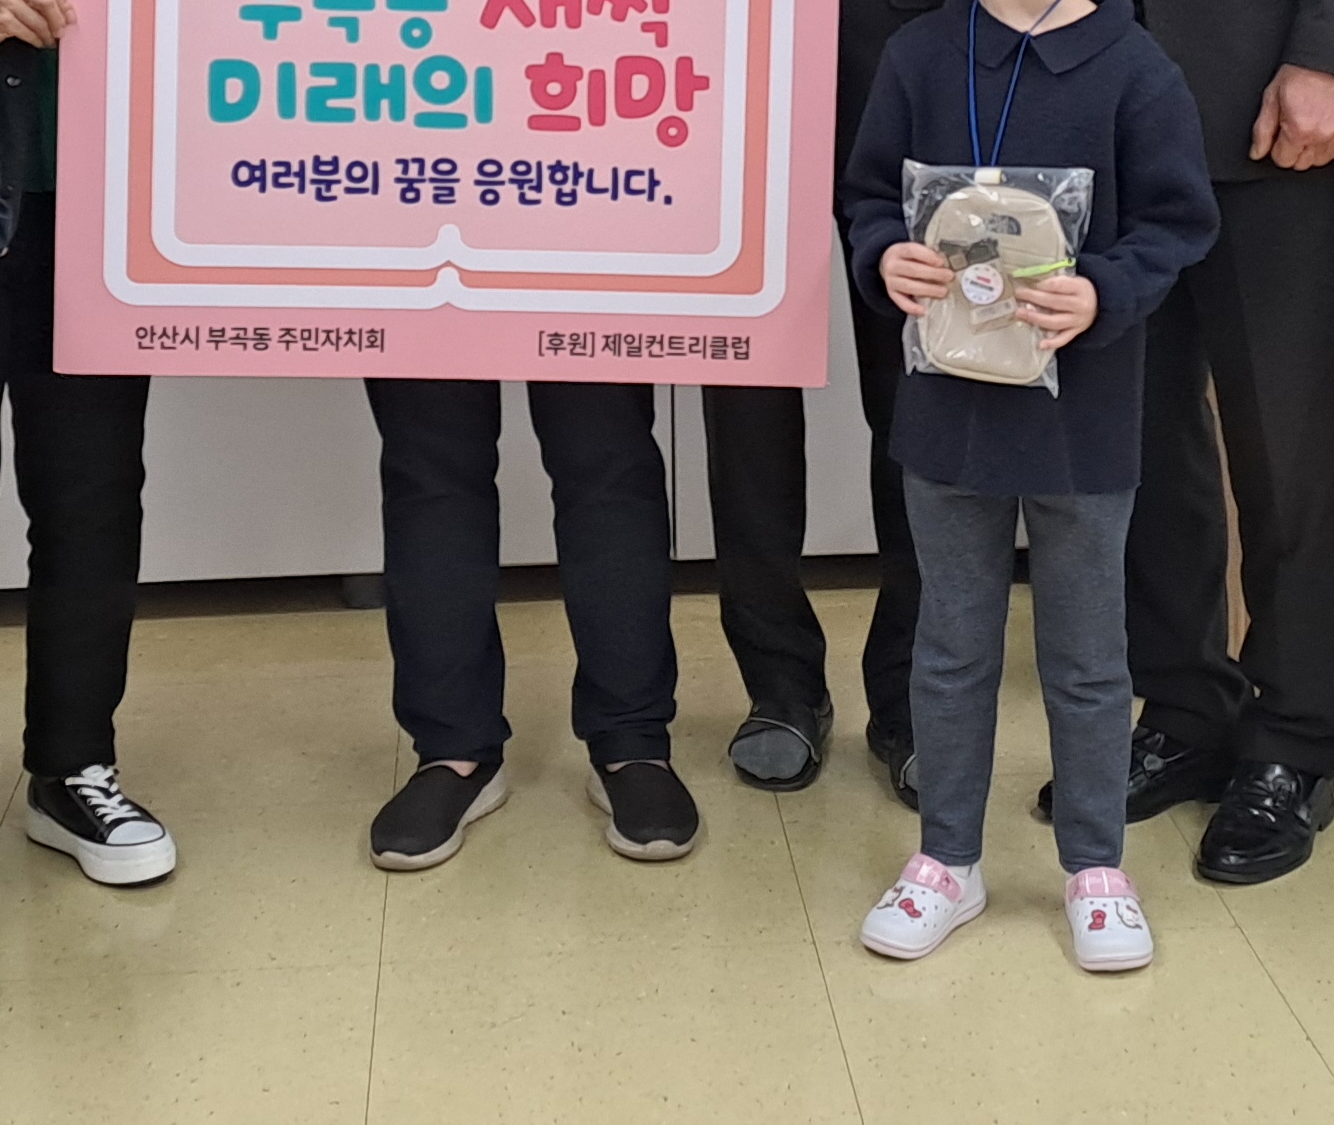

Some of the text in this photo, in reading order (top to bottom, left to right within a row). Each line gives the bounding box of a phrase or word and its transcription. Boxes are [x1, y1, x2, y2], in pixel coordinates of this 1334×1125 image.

[207, 51, 711, 149] 미래의 희망
[230, 155, 673, 208] 여러분의 꿈을 응원합니다.
[134, 325, 386, 353] 안산시 부곡동 주민자치회
[538, 330, 751, 360] [후원] 제일컨트리클럽
